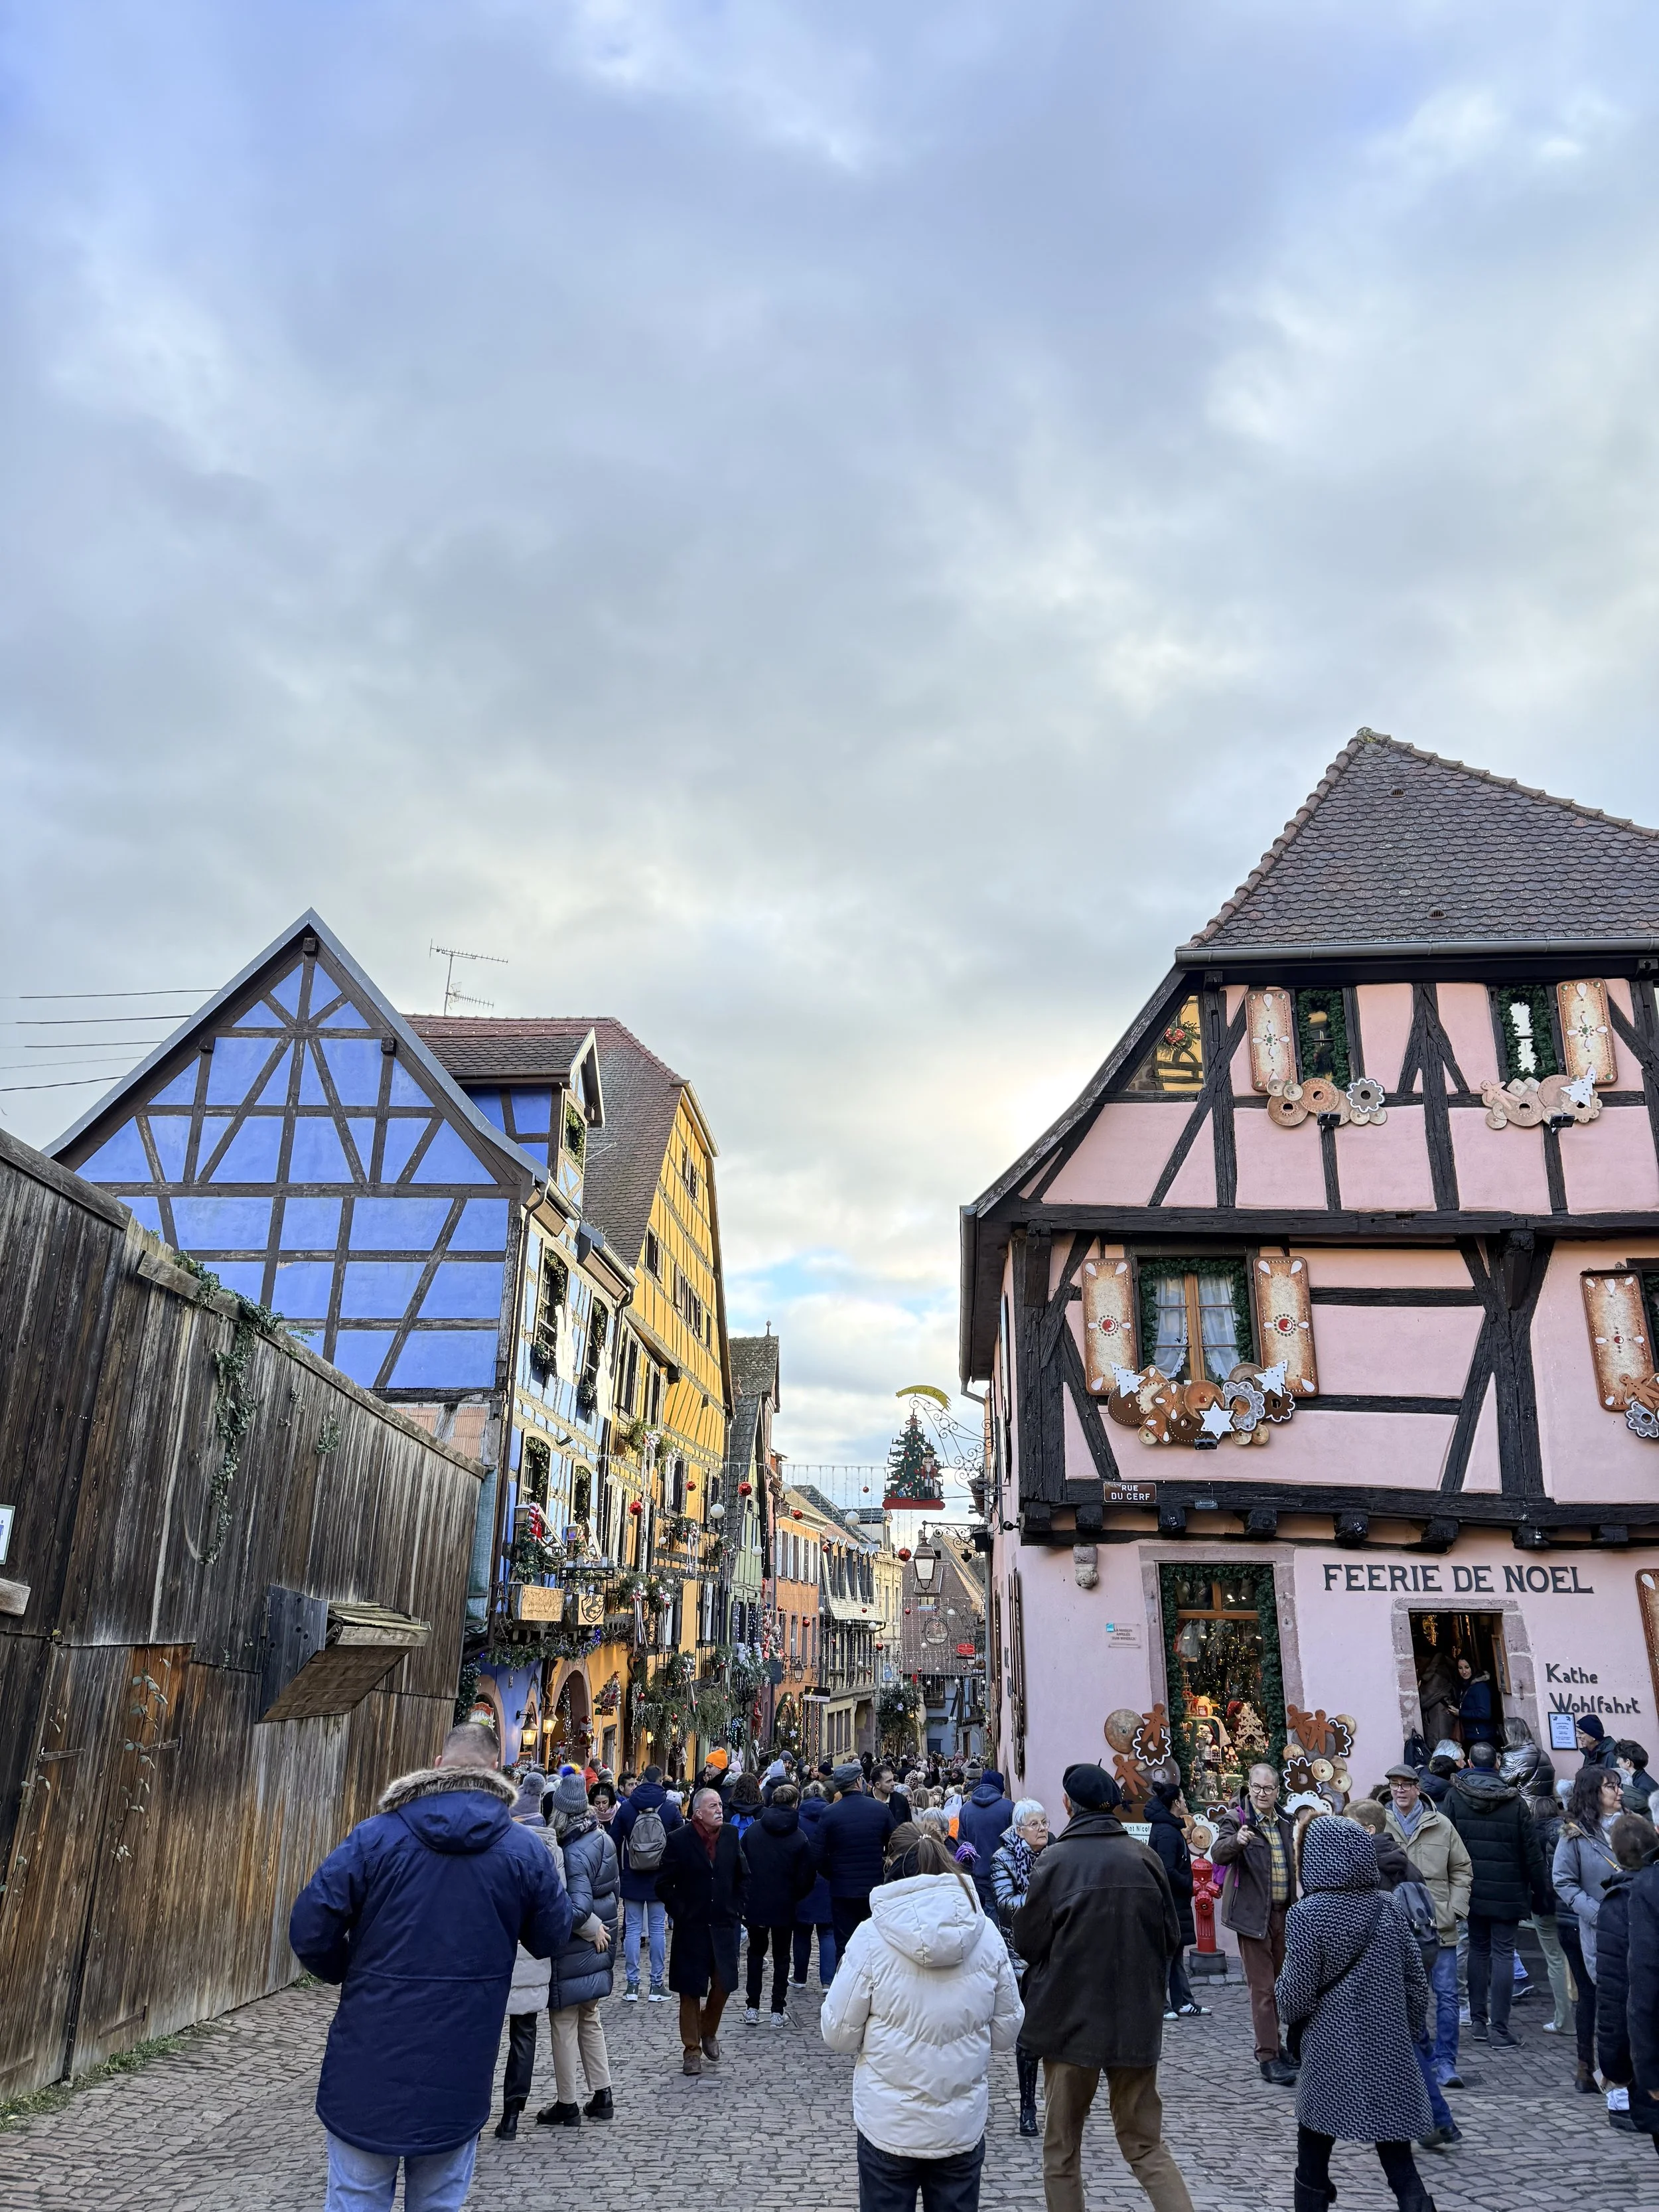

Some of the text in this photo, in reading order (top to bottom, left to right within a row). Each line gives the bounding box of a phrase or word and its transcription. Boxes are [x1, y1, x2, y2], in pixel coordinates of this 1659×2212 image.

[1111, 1492, 1151, 1501] DU CERF
[1323, 1564, 1594, 1594] FEERIE DE NOEL
[1546, 1663, 1598, 1684] Kathe
[1549, 1692, 1641, 1714] Wohlfahrt
